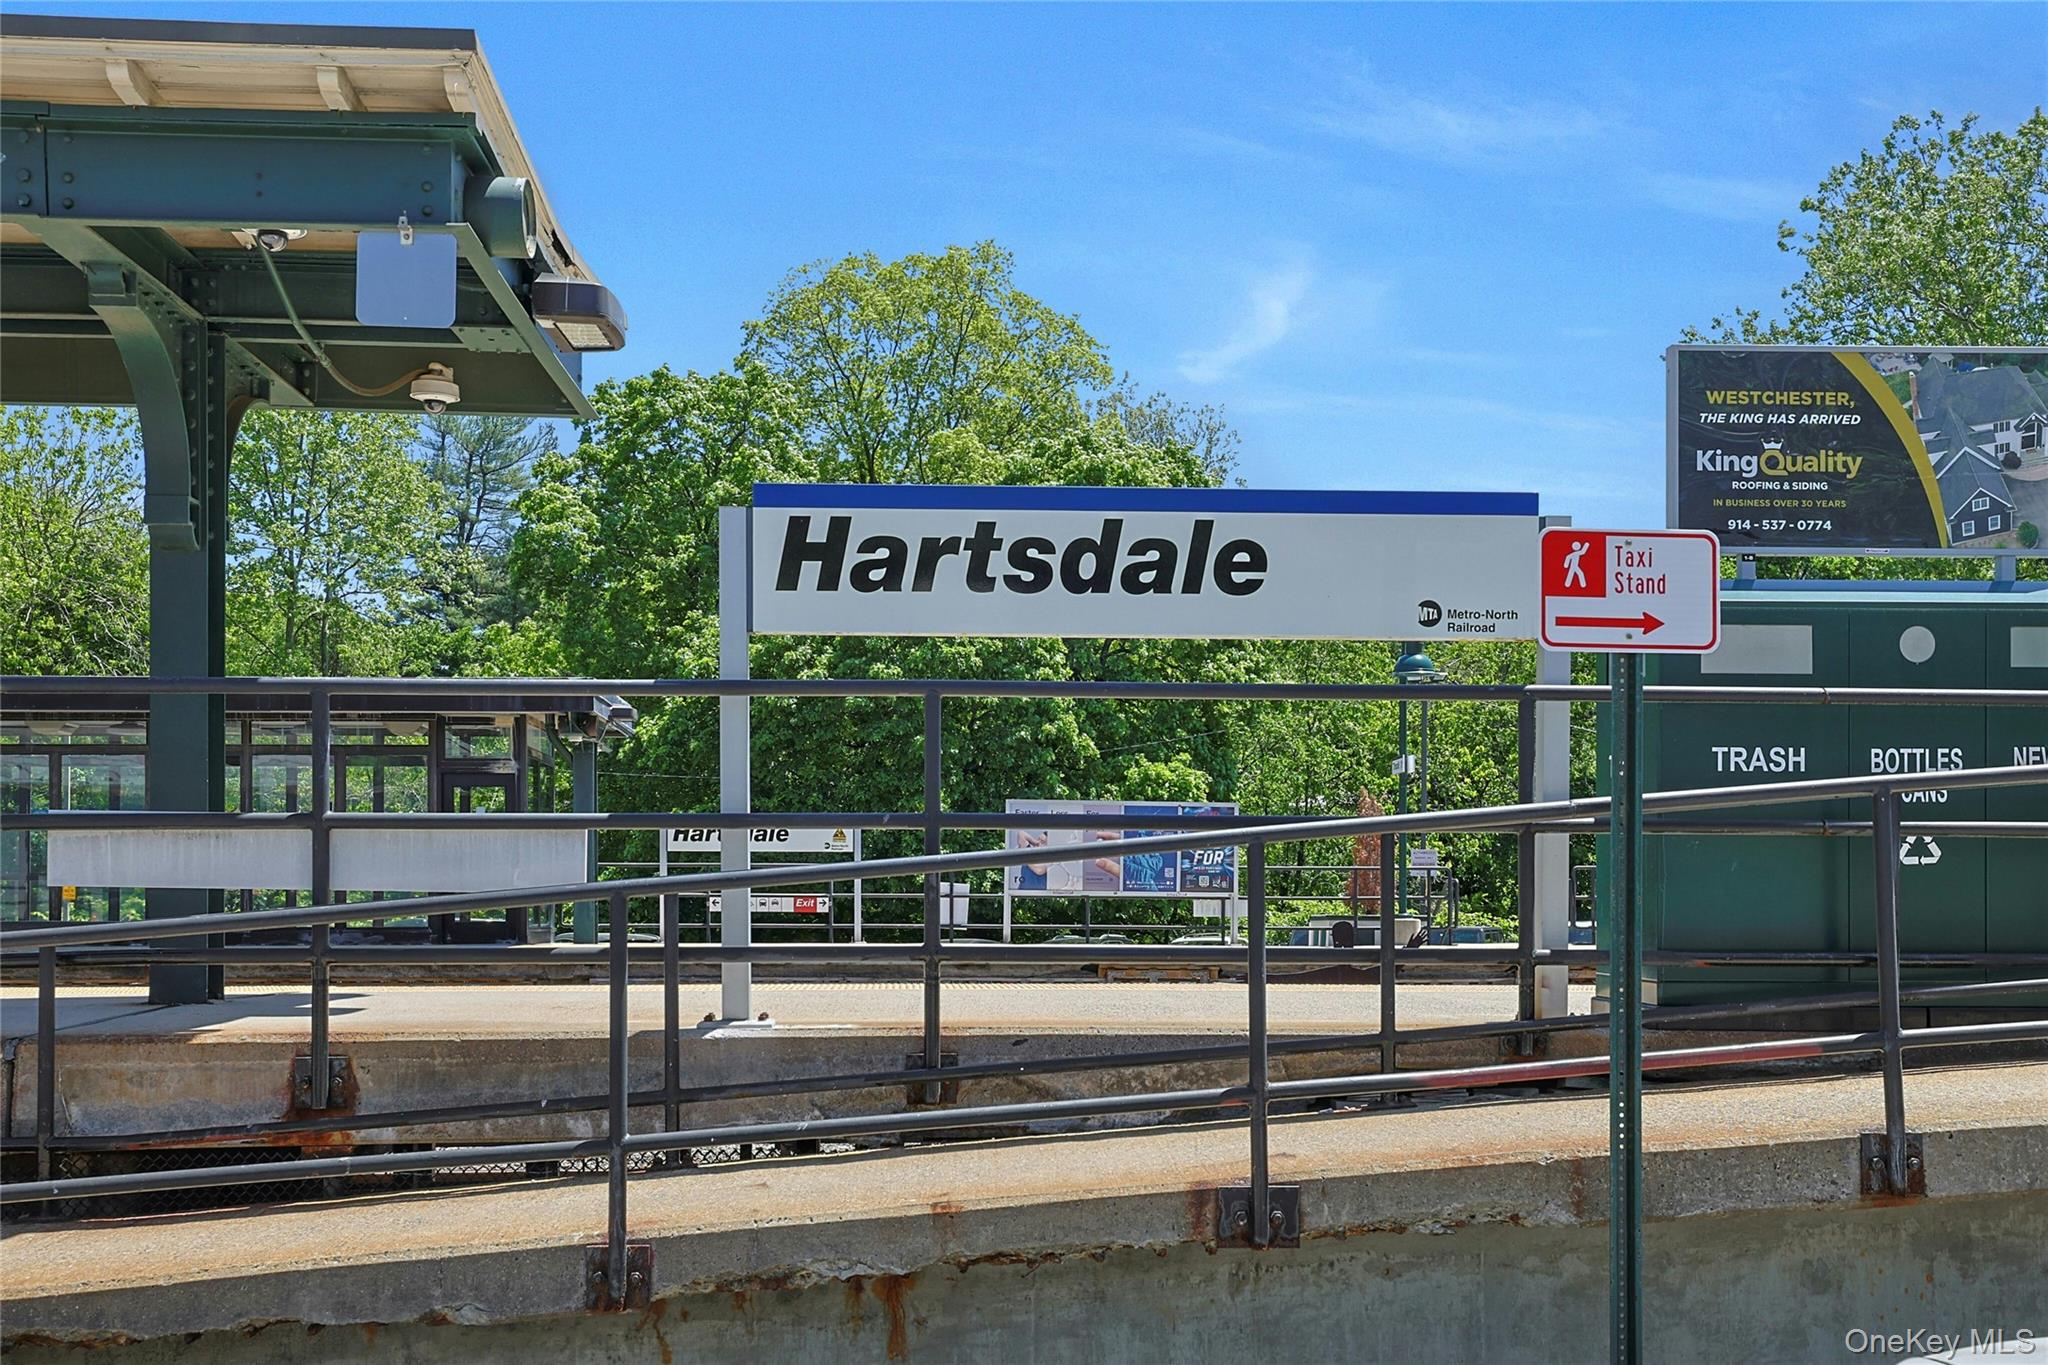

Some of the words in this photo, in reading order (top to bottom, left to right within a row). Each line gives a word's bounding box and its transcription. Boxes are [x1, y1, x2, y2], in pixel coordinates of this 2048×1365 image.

[1706, 391, 1855, 408] WESTCHESTER,
[1700, 413, 1727, 423] THE
[1729, 413, 1764, 424] KING
[1768, 414, 1796, 424] HAS
[1799, 414, 1861, 425] ARRIVED
[1732, 481, 1781, 490] ROOFING
[1783, 482, 1790, 490] &
[1792, 482, 1829, 490] SIDING
[1726, 499, 1771, 507] BUSINESS
[1801, 500, 1813, 508] 30
[1816, 500, 1847, 508] YEARS
[775, 515, 1268, 597] Hartsdale
[1614, 545, 1653, 568] Taxi
[1614, 572, 1667, 595] Stand
[1418, 604, 1440, 622] MTA
[1447, 609, 1518, 620] Metro-North
[1447, 622, 1496, 632] Railroad
[1711, 747, 1806, 772] TRASH
[1871, 748, 1964, 773] BOTTLES
[1193, 850, 1224, 865] FOR
[796, 899, 815, 907] Exit
